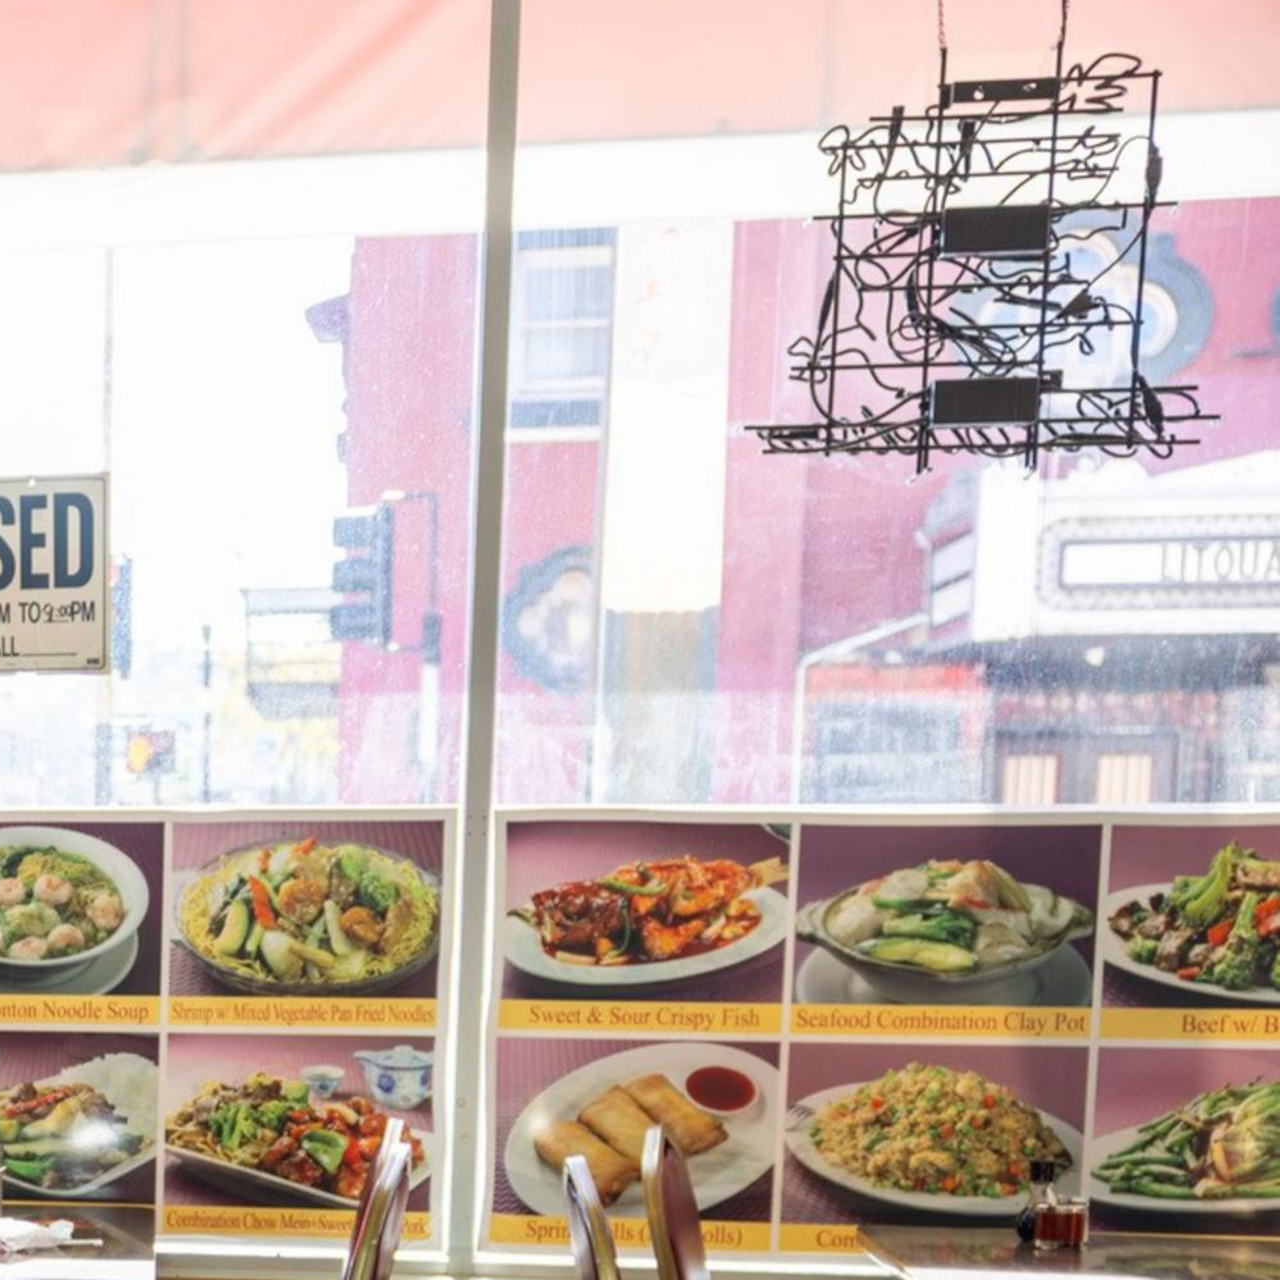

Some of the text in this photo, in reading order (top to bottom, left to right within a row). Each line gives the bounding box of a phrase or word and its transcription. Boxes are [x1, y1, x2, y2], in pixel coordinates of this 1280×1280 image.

[19, 601, 41, 624] TO
[71, 601, 95, 622] PM
[43, 1001, 102, 1019] Noodle
[106, 1002, 149, 1023] Soup
[171, 1003, 213, 1024] Shrimp
[232, 1004, 271, 1021] Mixed
[273, 1004, 328, 1026] Vegetable
[331, 1006, 352, 1022] Pan
[356, 1005, 387, 1022] Fried
[389, 1004, 434, 1023] Noodles
[529, 1005, 760, 1031] Sweet & Sour Crispy Fish
[797, 1009, 1086, 1036] Seafood Combination Clay Pot
[1182, 1013, 1229, 1033] Beef
[1234, 1015, 1259, 1033] w/
[167, 1210, 240, 1231] Combination
[243, 1212, 277, 1230] Chow
[526, 1220, 571, 1243] Sprin
[702, 1226, 743, 1246] olls)
